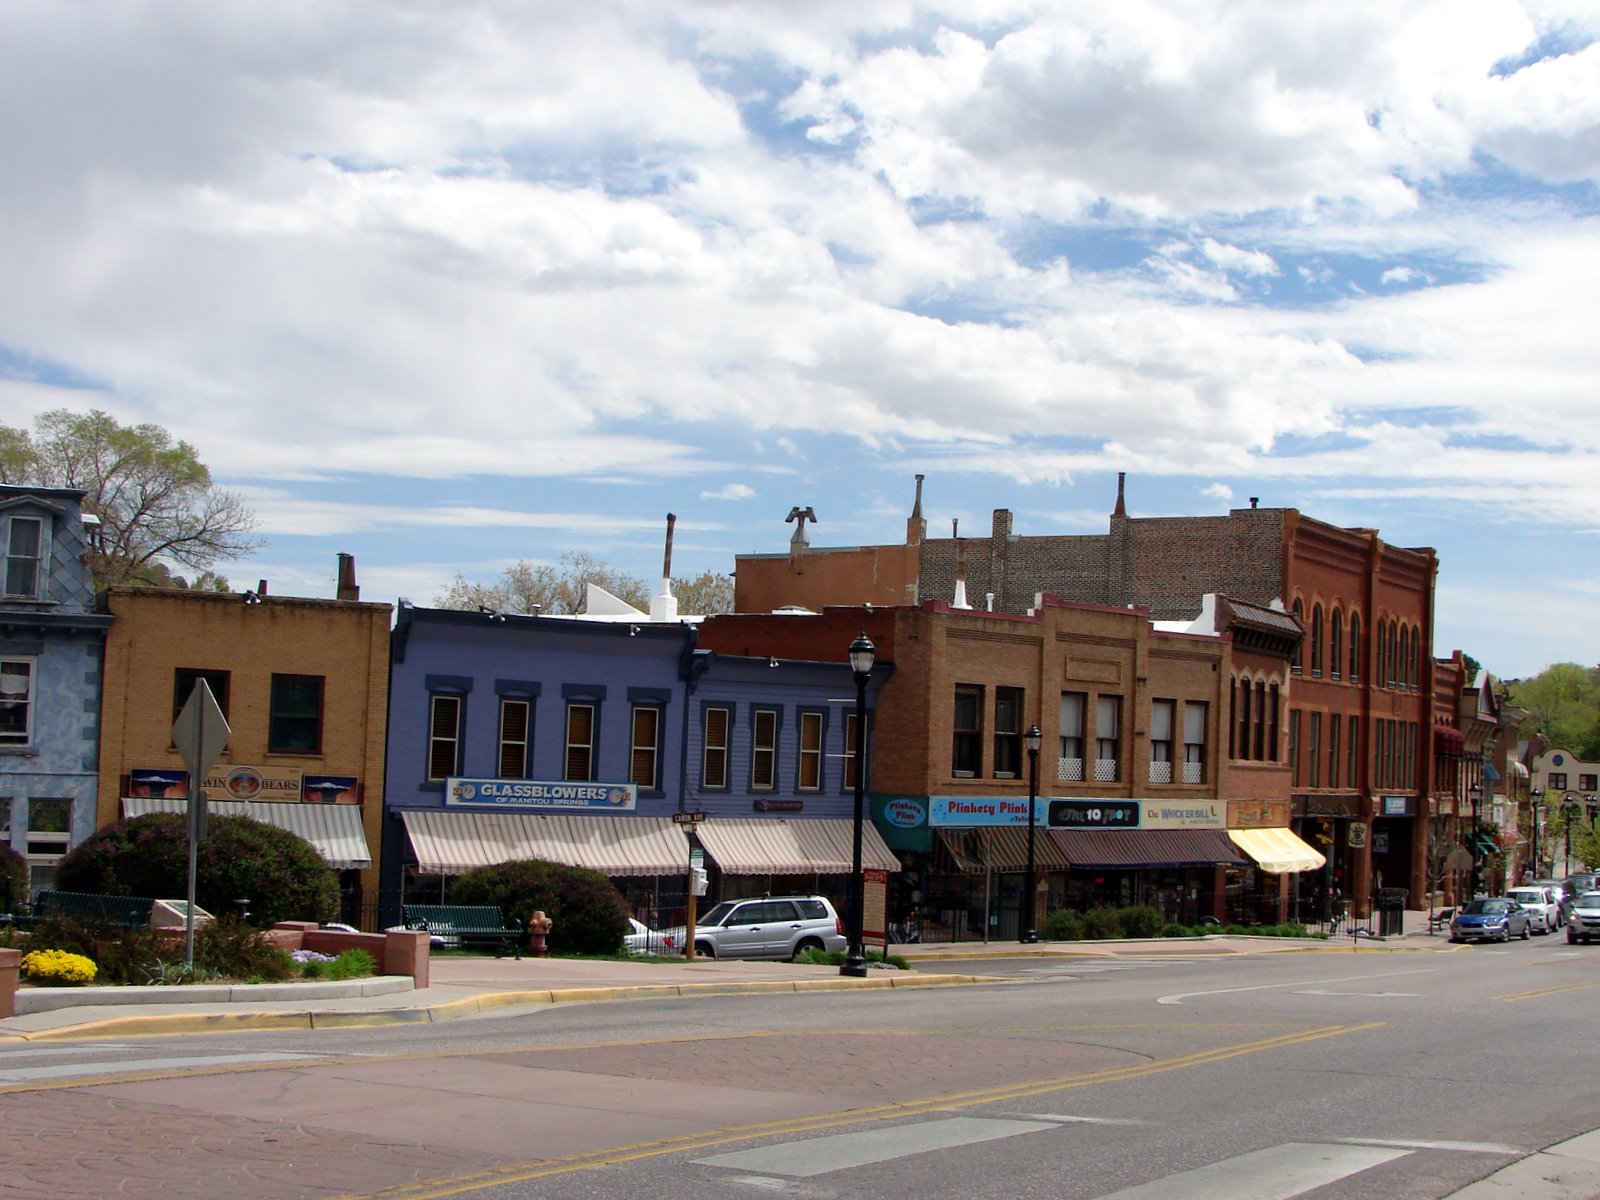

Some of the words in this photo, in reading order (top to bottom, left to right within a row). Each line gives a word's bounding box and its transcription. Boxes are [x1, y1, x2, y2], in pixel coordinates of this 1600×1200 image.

[261, 780, 298, 790] BEARS
[481, 784, 607, 800] GLASSBLOWERS
[889, 802, 921, 814] Plinkety
[948, 801, 995, 815] Plinkety
[1000, 801, 1028, 814] Plink
[896, 811, 915, 820] Plink
[1086, 808, 1102, 821] 10
